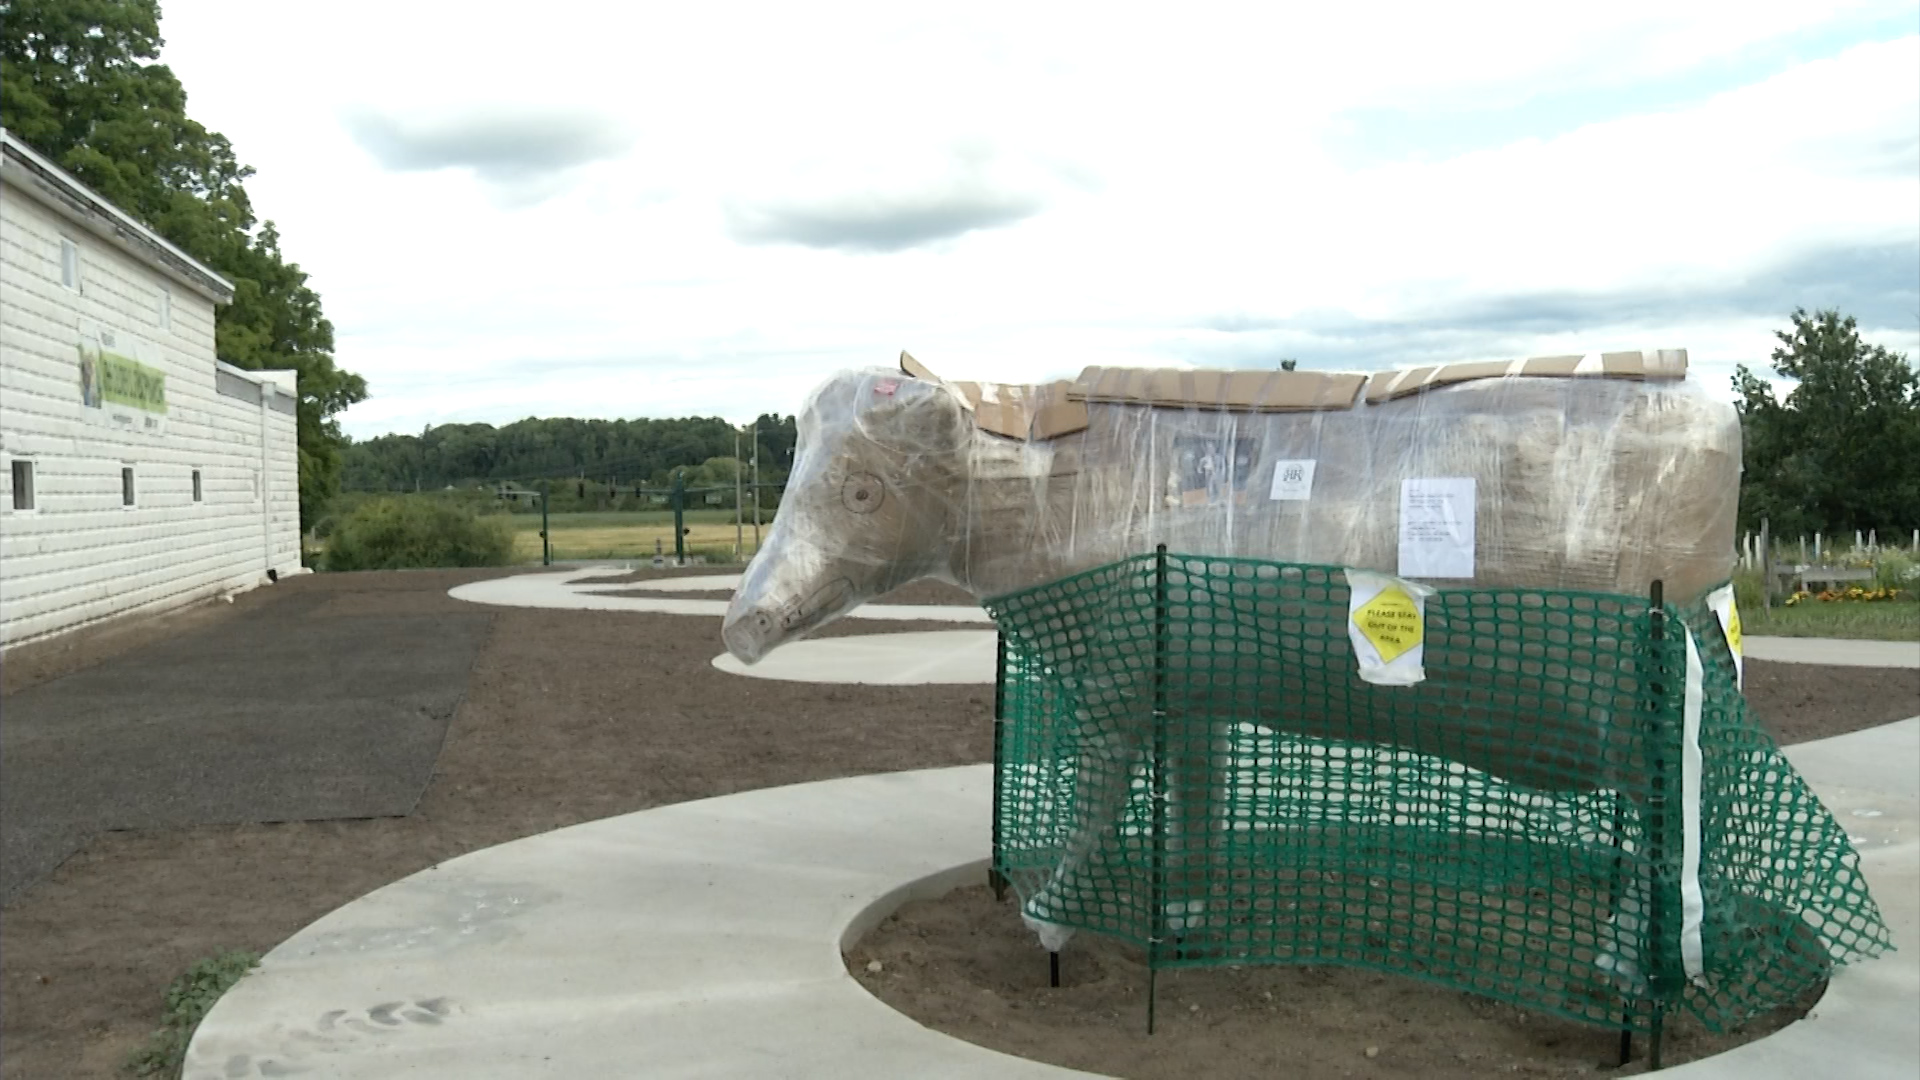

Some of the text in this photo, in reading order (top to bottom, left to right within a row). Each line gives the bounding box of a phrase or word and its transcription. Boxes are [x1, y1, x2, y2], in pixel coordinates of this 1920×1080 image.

[1367, 609, 1416, 619] PLEASE STAY
[1367, 621, 1385, 629] OUT
[1400, 625, 1414, 633] THE
[1380, 635, 1401, 643] AREA
